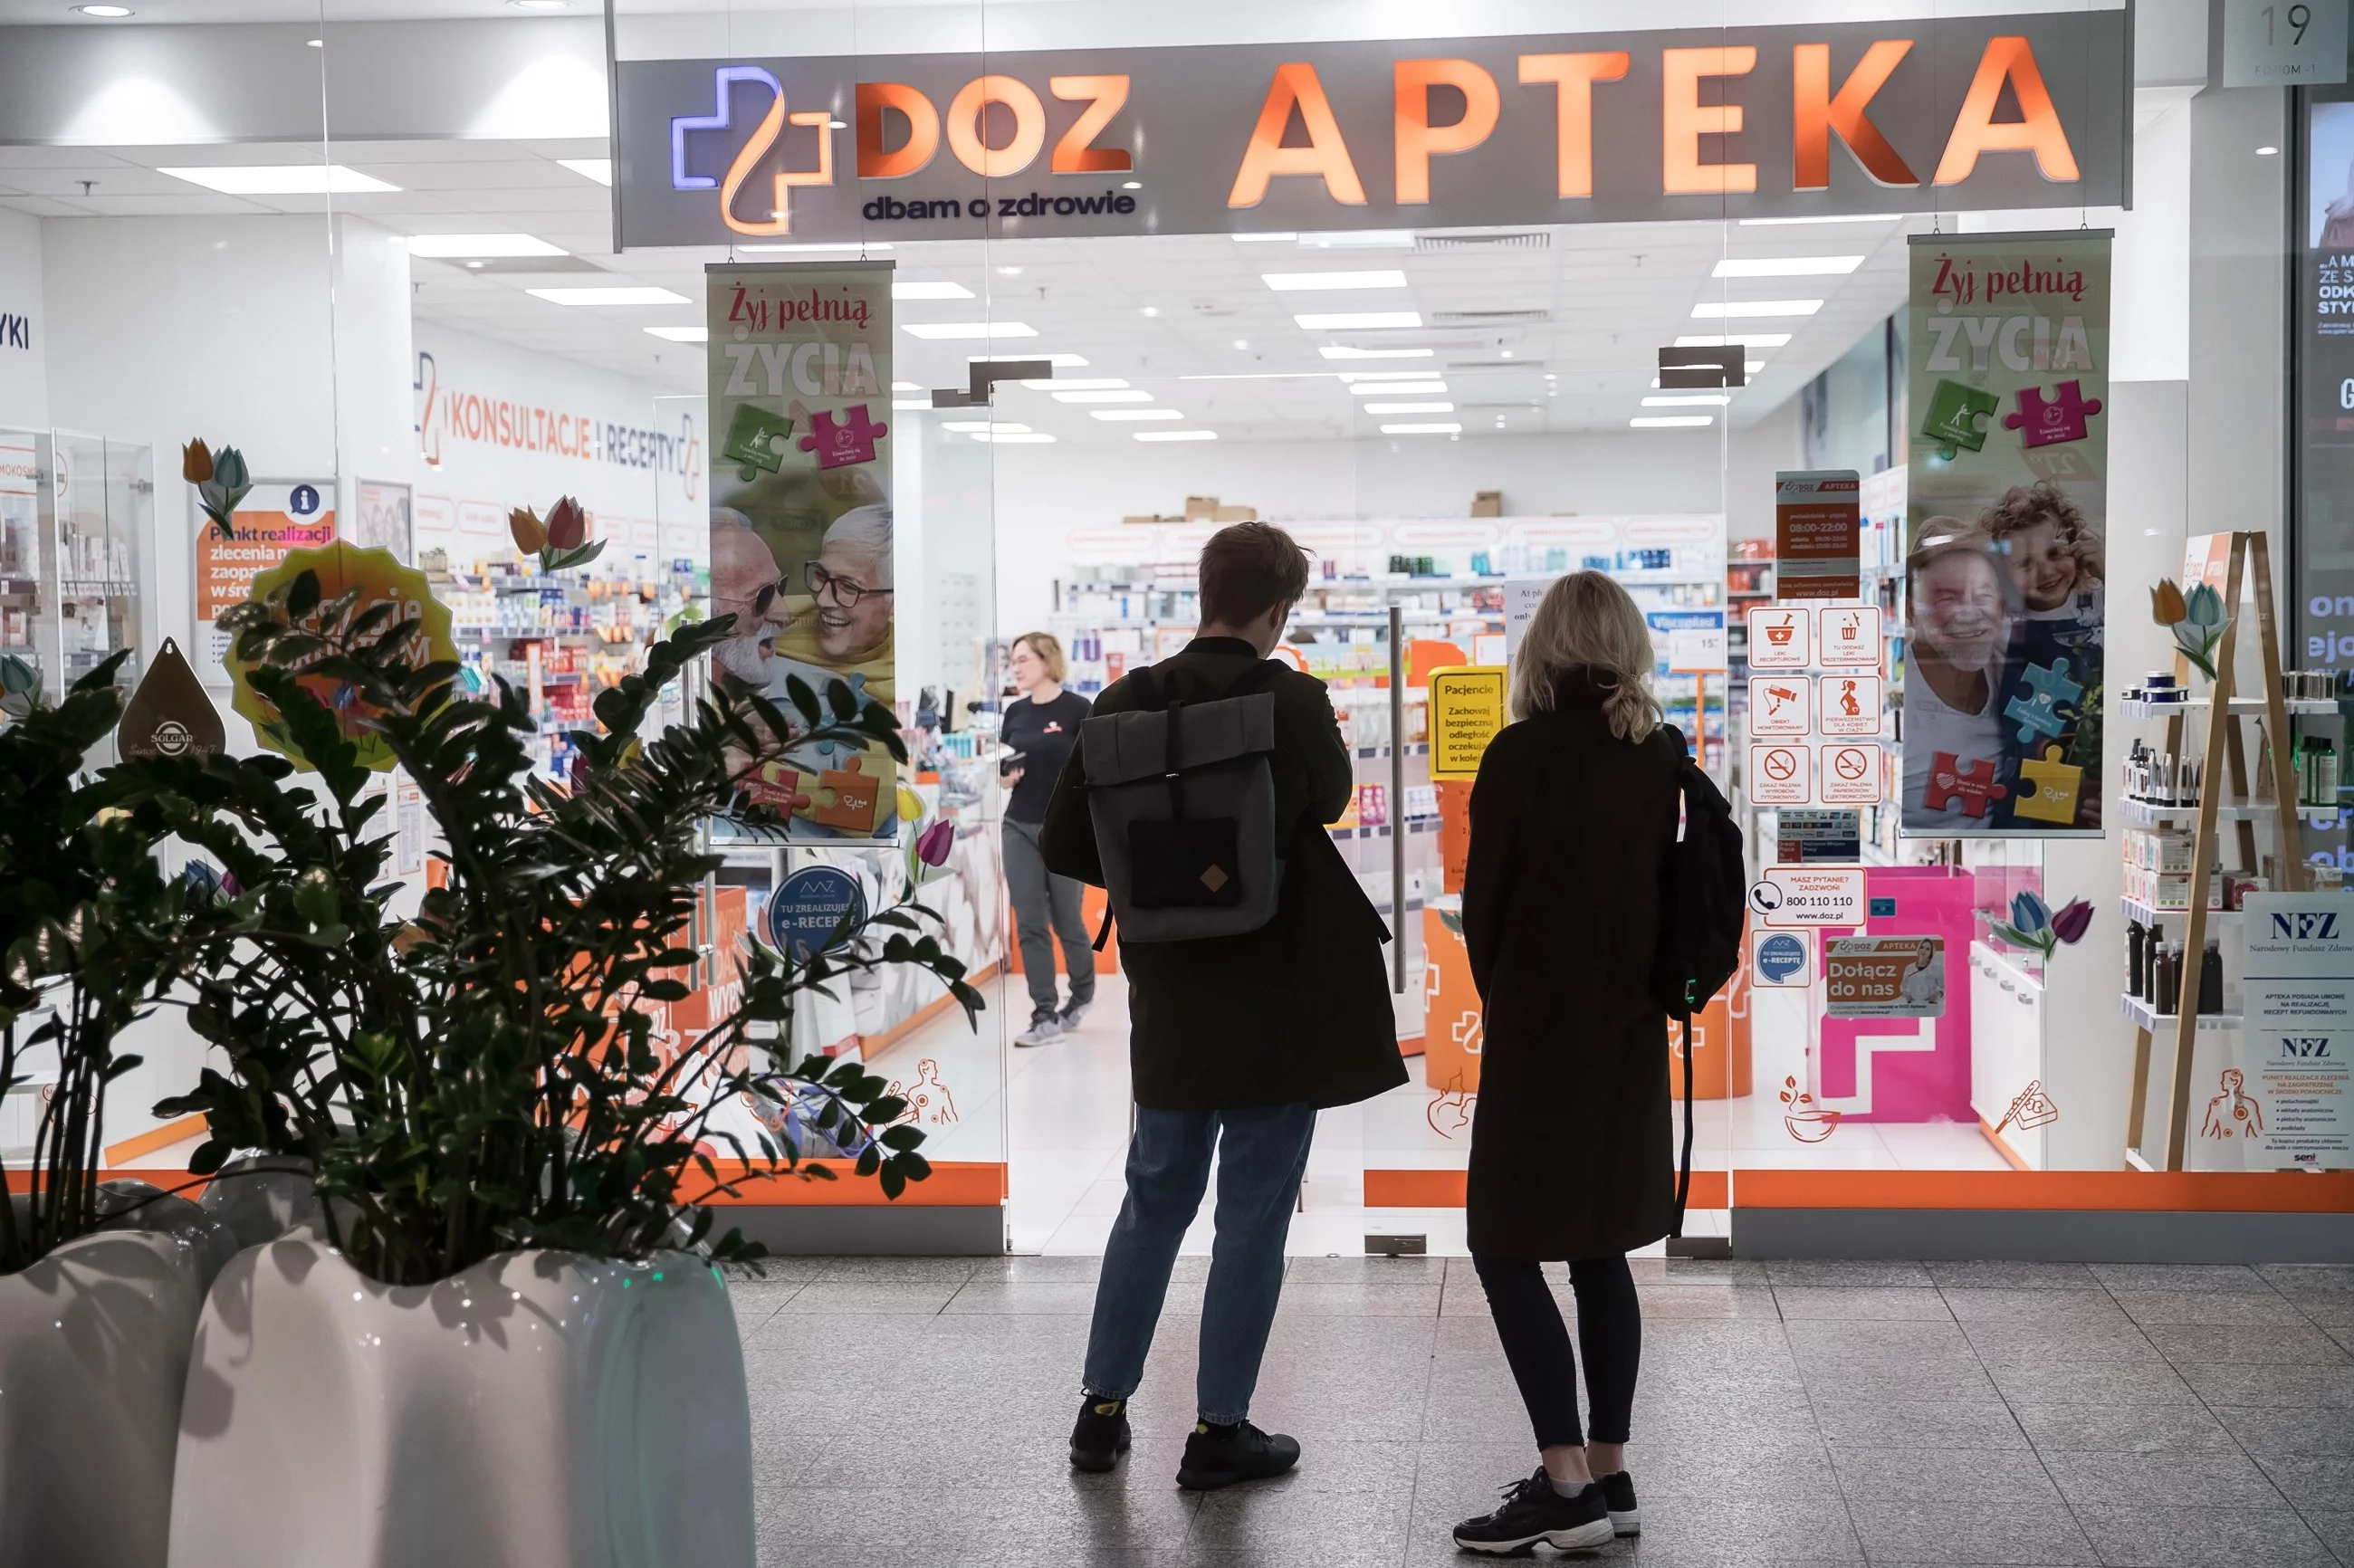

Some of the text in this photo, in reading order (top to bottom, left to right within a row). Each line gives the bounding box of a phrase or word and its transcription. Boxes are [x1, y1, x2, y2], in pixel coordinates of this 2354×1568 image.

[2262, 5, 2311, 45] 19
[855, 36, 2081, 207] DOZ APTEKA
[862, 190, 1136, 221] dbam o zdrowie
[1932, 252, 2089, 306] Żyj pełnią
[728, 281, 873, 333] Żyj pełnią
[1924, 297, 2094, 372] ŻYCIA
[723, 324, 880, 397] ŻYCIA
[452, 391, 591, 460] KONSULTACJE
[607, 424, 675, 474] RECEPTY
[210, 526, 331, 544] Pnkt realizacji
[210, 545, 275, 560] zlecenia
[210, 585, 225, 598] w
[1795, 589, 1839, 598] www.doz.pl
[1444, 684, 1494, 696] Pacjencie
[1448, 707, 1490, 716] Zachowaj
[1445, 719, 1494, 728] bezpieczną
[150, 734, 194, 742] SOLGAR
[1449, 730, 1490, 740] odległość
[129, 743, 216, 756] Since 1947
[1786, 896, 1853, 906] 800 110 110
[780, 905, 794, 913] TU
[1795, 912, 1843, 921] www.doz.pl
[2270, 912, 2340, 940] NFZ
[2249, 943, 2291, 954] Narodowy
[2292, 943, 2325, 952] Fundusz
[1762, 957, 1801, 965] e-RECEPTĘ
[1828, 961, 1898, 980] Dołącz
[1829, 980, 1895, 997] do nas
[2281, 1037, 2331, 1057] NFZ
[2293, 1152, 2316, 1162] seni
